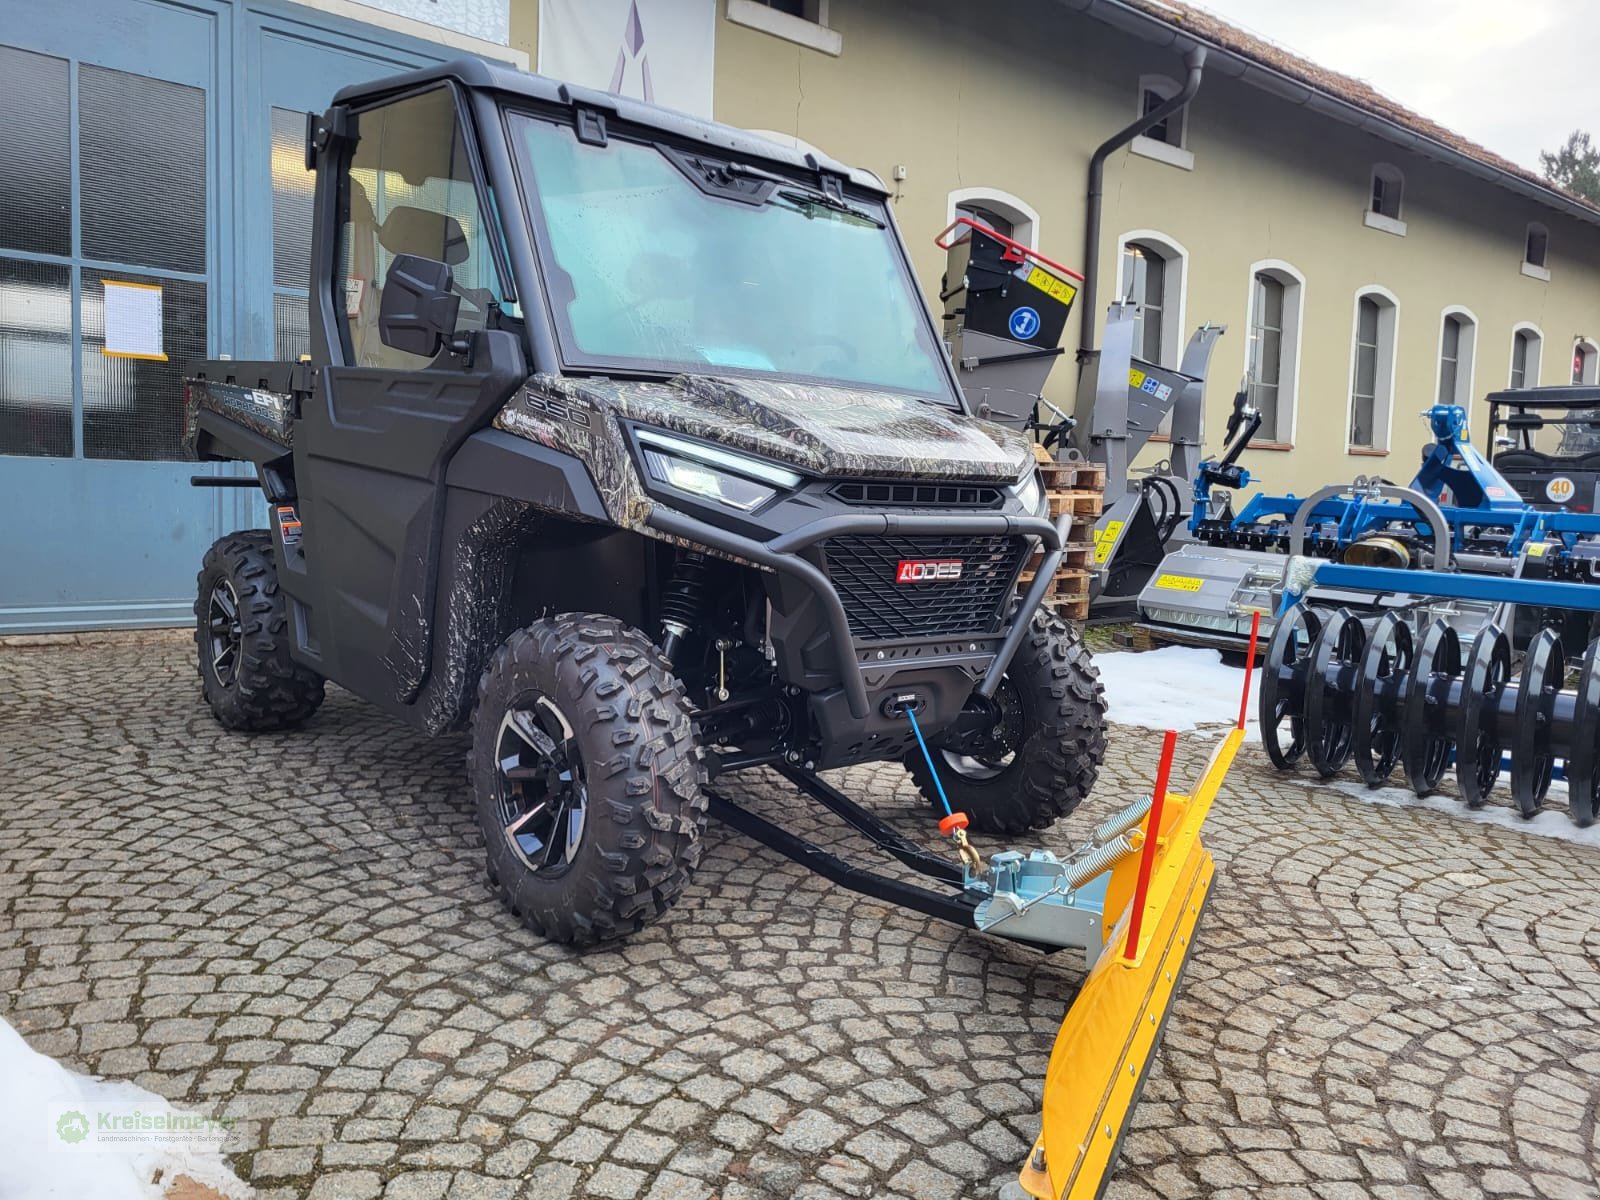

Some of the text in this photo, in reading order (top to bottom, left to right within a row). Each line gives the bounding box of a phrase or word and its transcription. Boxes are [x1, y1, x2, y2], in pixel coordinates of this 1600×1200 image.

[525, 391, 591, 429] 650
[1551, 480, 1570, 494] 40
[900, 563, 962, 579] AODES
